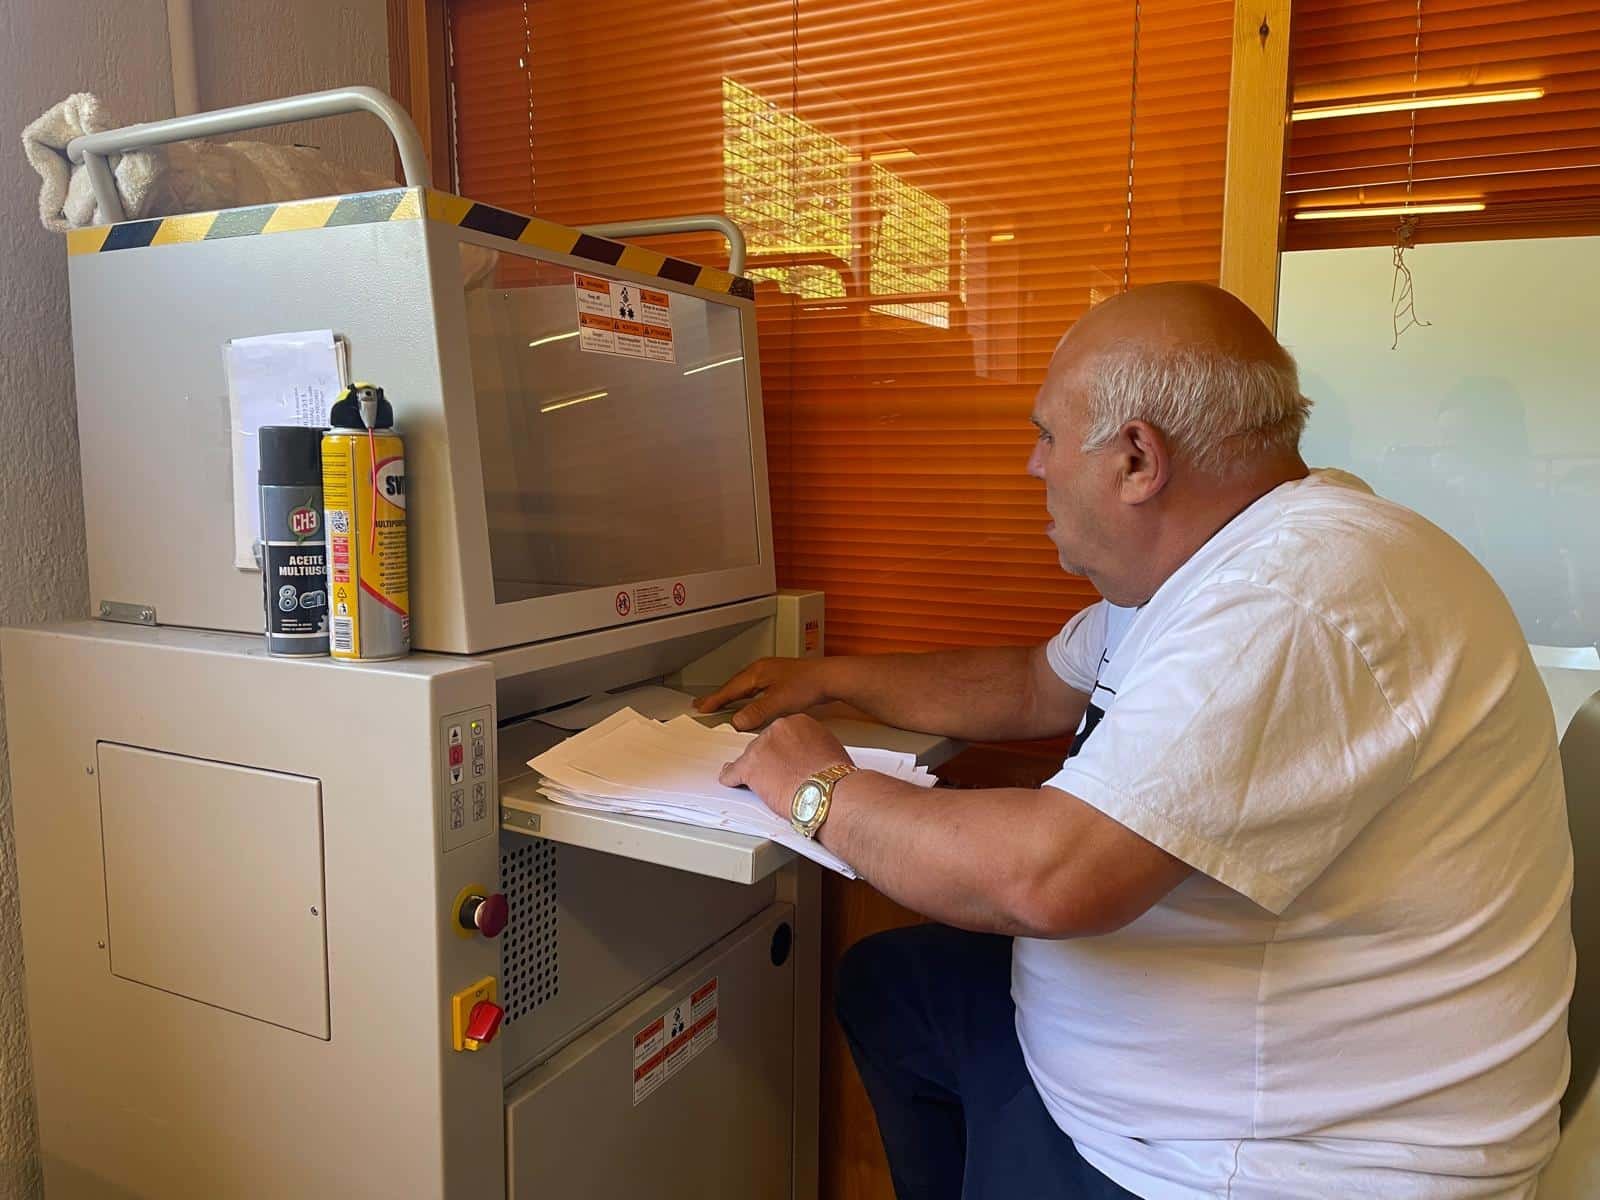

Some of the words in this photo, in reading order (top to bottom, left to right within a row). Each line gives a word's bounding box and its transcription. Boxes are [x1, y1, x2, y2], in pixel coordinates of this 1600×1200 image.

[293, 511, 317, 532] CH3
[289, 555, 324, 566] ACEITE
[279, 566, 327, 577] MULTIUSO
[278, 584, 298, 612] 8
